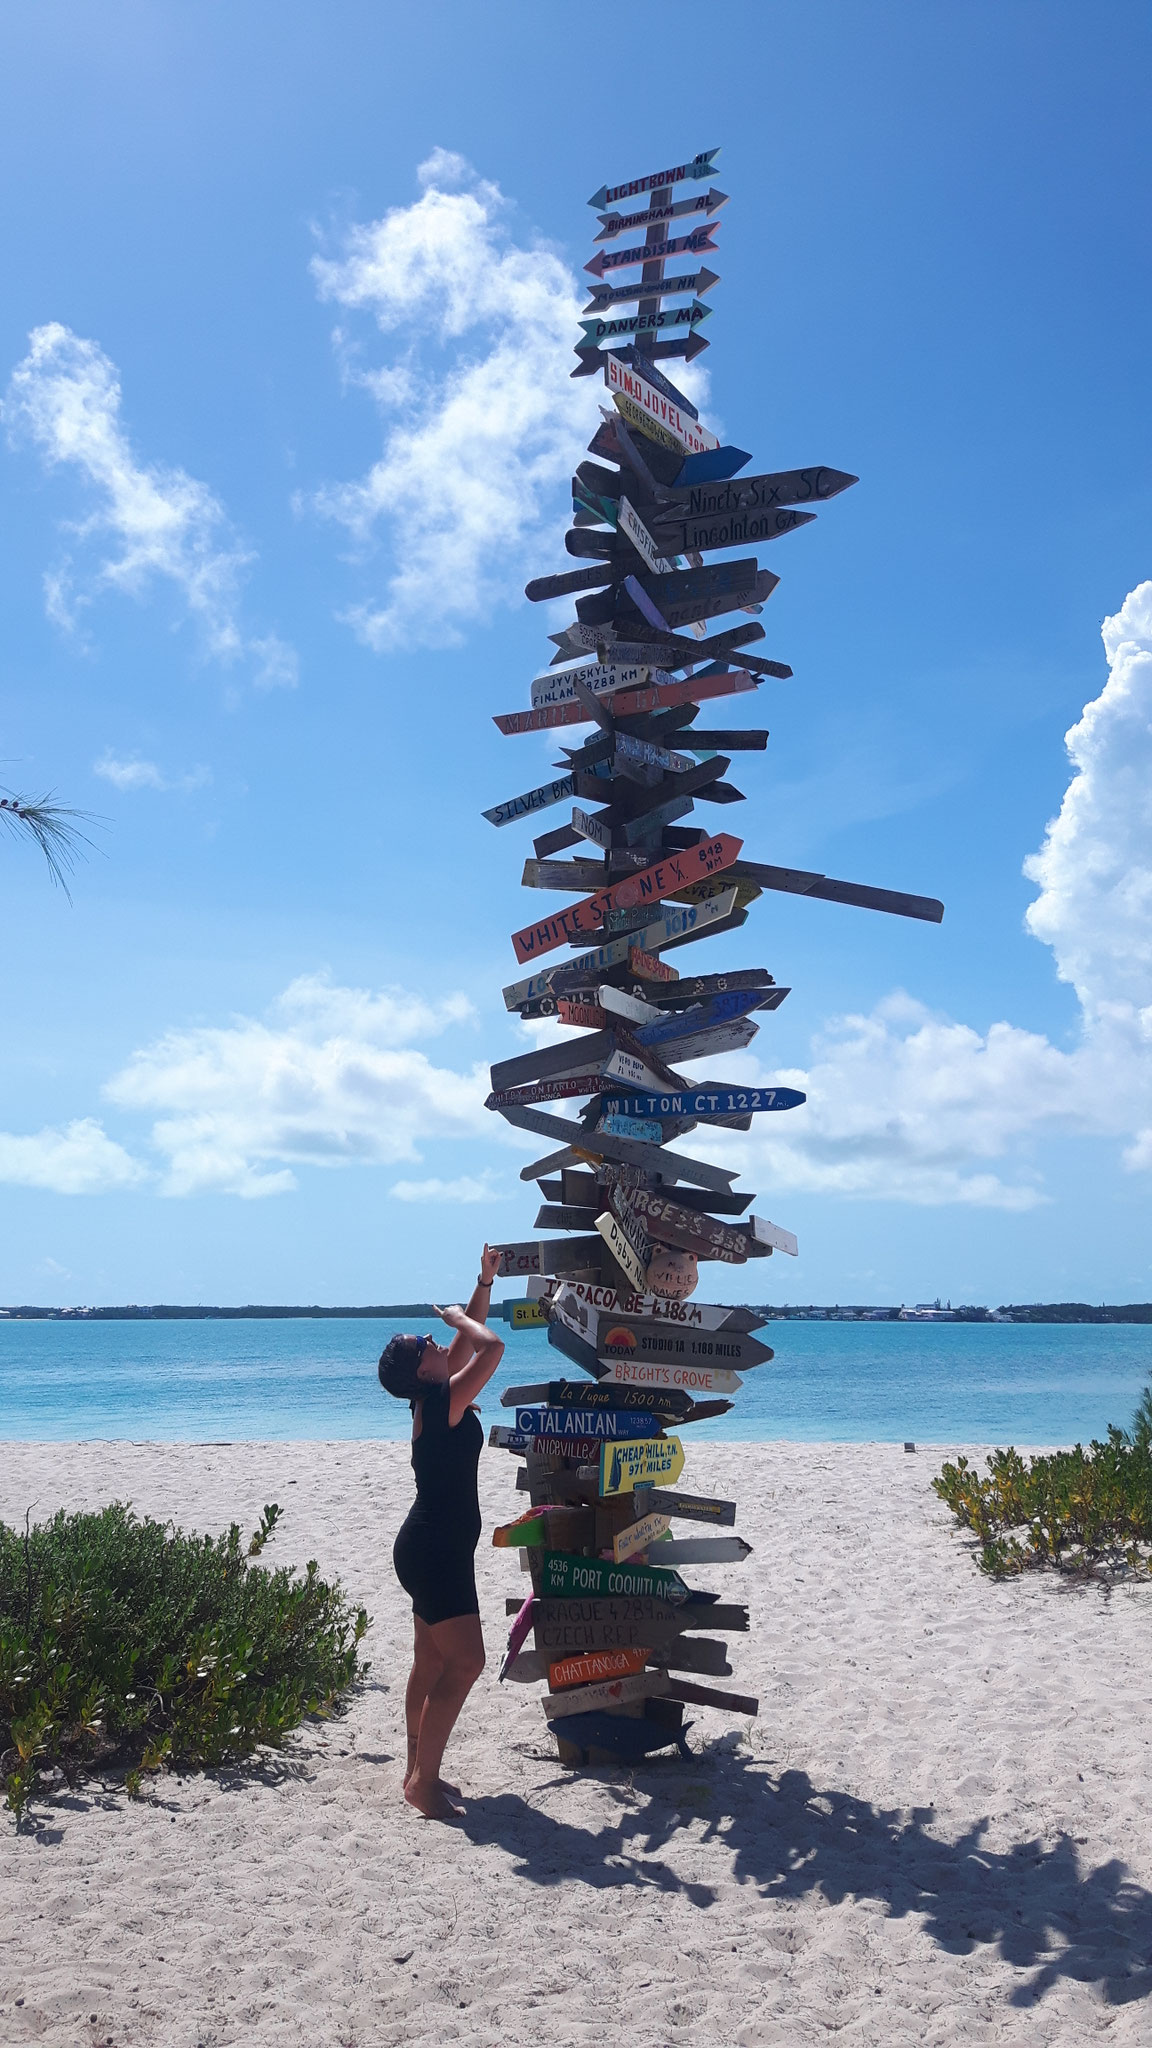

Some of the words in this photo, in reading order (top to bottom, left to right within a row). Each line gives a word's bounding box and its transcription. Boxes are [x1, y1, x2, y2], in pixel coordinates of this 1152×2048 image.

[607, 205, 674, 232] BIRMINGHAM
[601, 239, 677, 269] STANDISH
[683, 231, 708, 250] ME
[596, 312, 667, 337] DANVERS
[675, 306, 704, 324] MA
[749, 480, 782, 505] Six
[796, 467, 830, 498] SC
[775, 510, 798, 530] GA
[533, 686, 577, 707] FINLAN
[621, 668, 638, 682] KM
[494, 788, 546, 822] SILVER
[551, 777, 575, 800] BAY
[519, 905, 584, 952] WHITE
[531, 1081, 577, 1095] ONTARIO
[727, 1091, 776, 1110] 1227
[516, 1309, 529, 1319] St.
[604, 1345, 636, 1356] TODAY
[641, 1337, 673, 1352] STUDIO
[715, 1343, 741, 1358] MILES
[615, 1363, 670, 1383] BRIGHT'S
[673, 1369, 713, 1389] GROVE
[623, 1391, 655, 1406] 1500
[616, 1446, 644, 1463] CHEAP
[628, 1463, 643, 1476] 971
[646, 1459, 672, 1473] MILES
[547, 1559, 569, 1573] 4536
[550, 1573, 565, 1588] KM
[572, 1567, 603, 1591] PORT
[542, 1625, 594, 1647] CZECH
[554, 1652, 630, 1683] CHATTANOOGA
